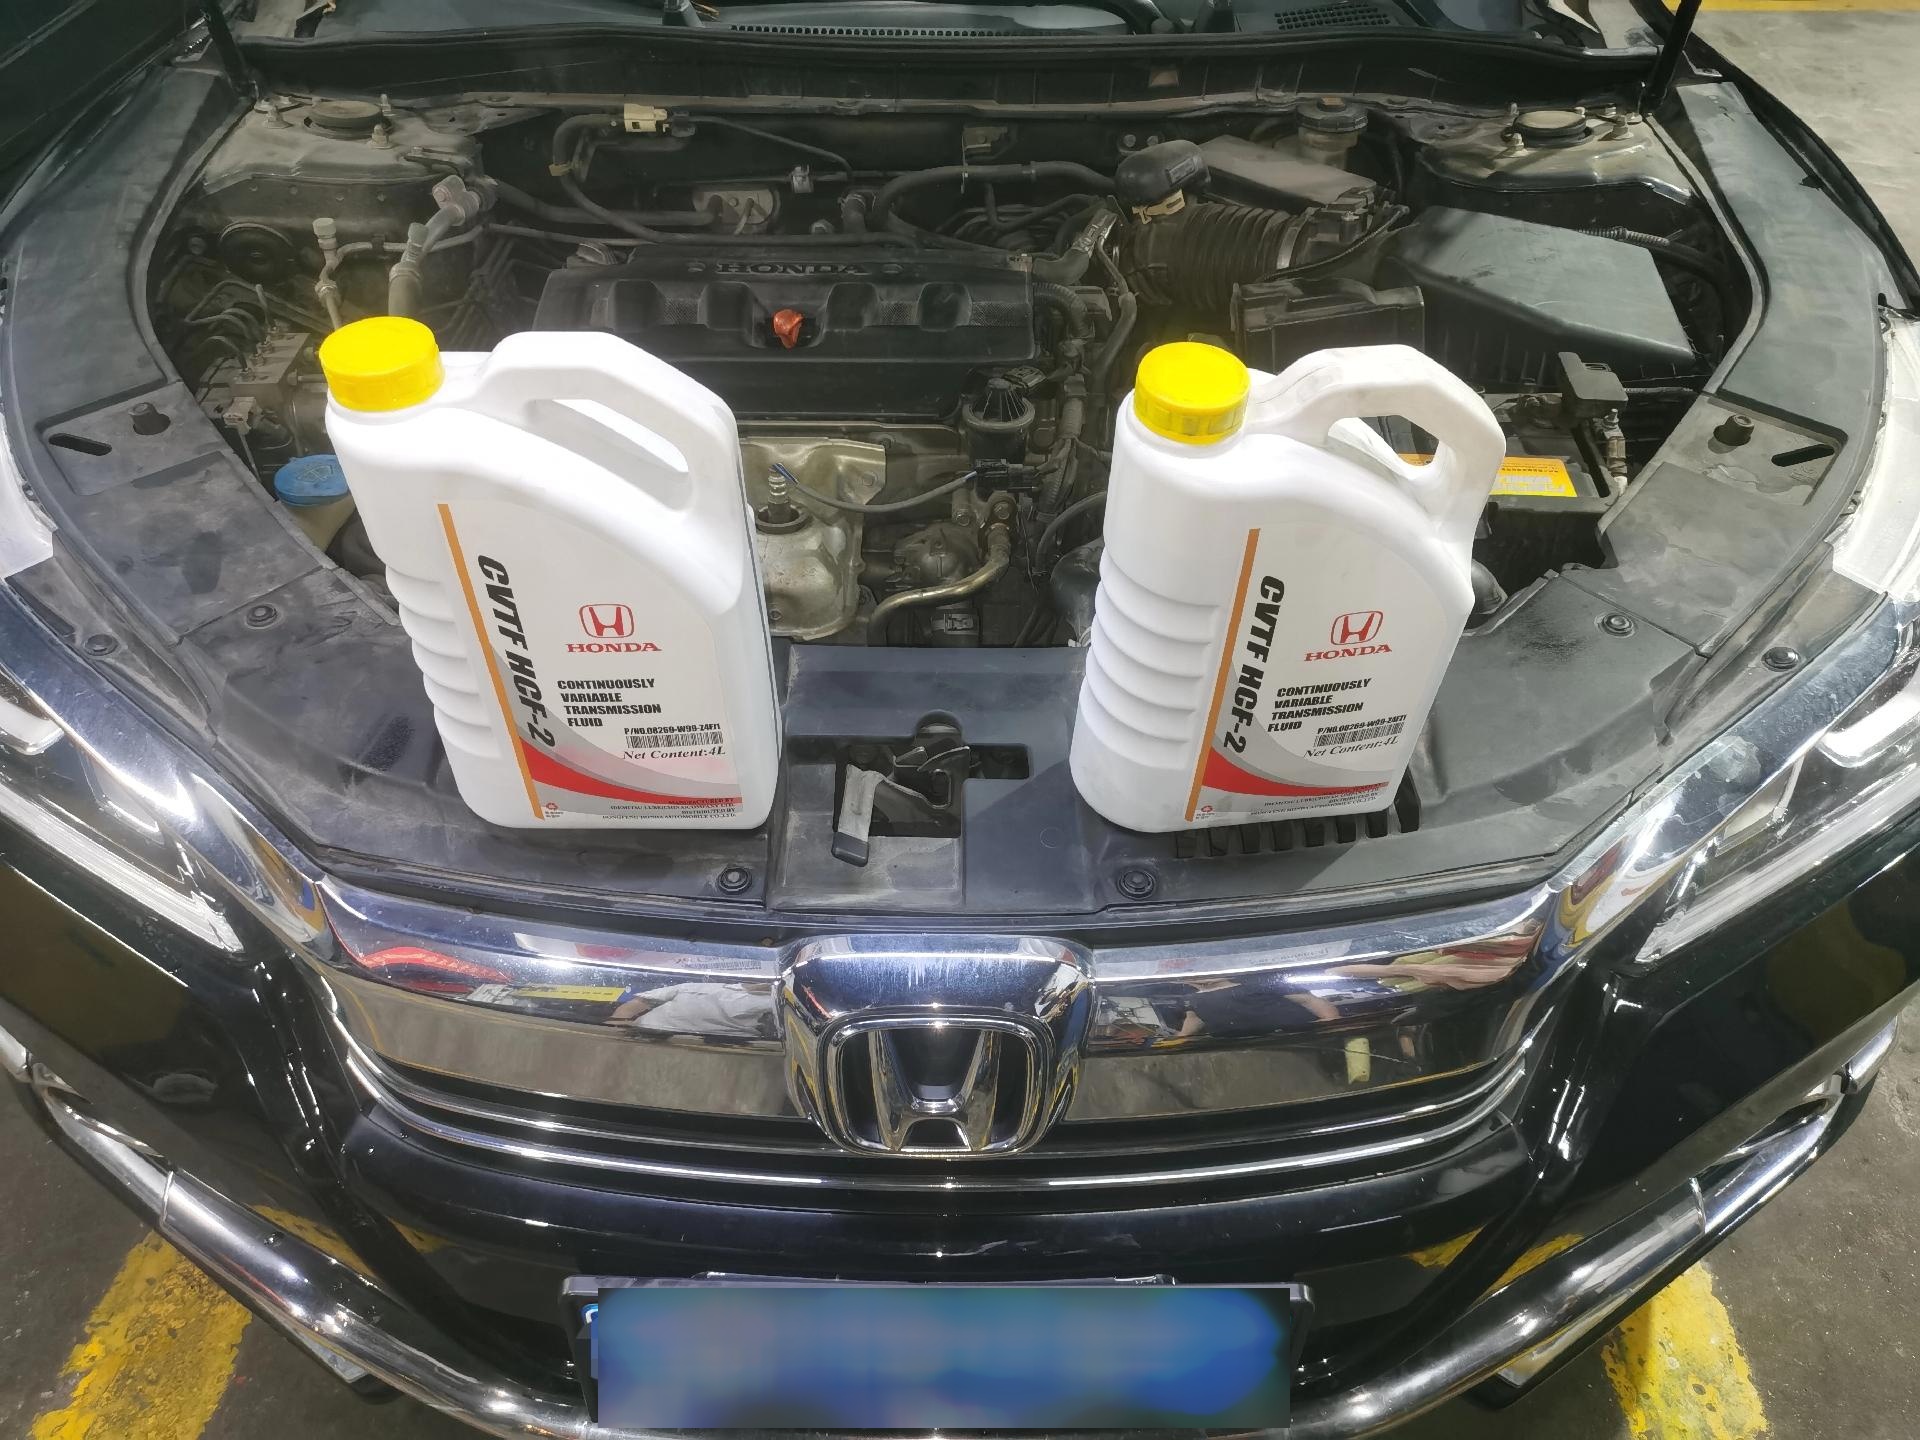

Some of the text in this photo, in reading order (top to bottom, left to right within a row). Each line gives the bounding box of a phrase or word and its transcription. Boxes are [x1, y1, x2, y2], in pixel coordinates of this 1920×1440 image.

[715, 262, 872, 276] HONDA
[477, 555, 556, 748] CVTF HCF-2
[565, 642, 663, 653] HONDA
[1304, 643, 1392, 662] HONDA
[1223, 575, 1285, 754] CVTF HCF-2
[557, 678, 655, 690] CONTINUOUSLY
[1276, 677, 1372, 698] CONTINUOUSLY
[560, 692, 623, 703] VARIABLE
[1274, 694, 1333, 709] VARIABLE
[563, 704, 662, 715] TRANSMISSION
[1271, 702, 1364, 721] TRANSMISSION
[567, 717, 603, 727] FLUID
[1267, 721, 1303, 732] FLUID
[623, 745, 726, 760] Net Content:4L
[1303, 748, 1326, 758] Net
